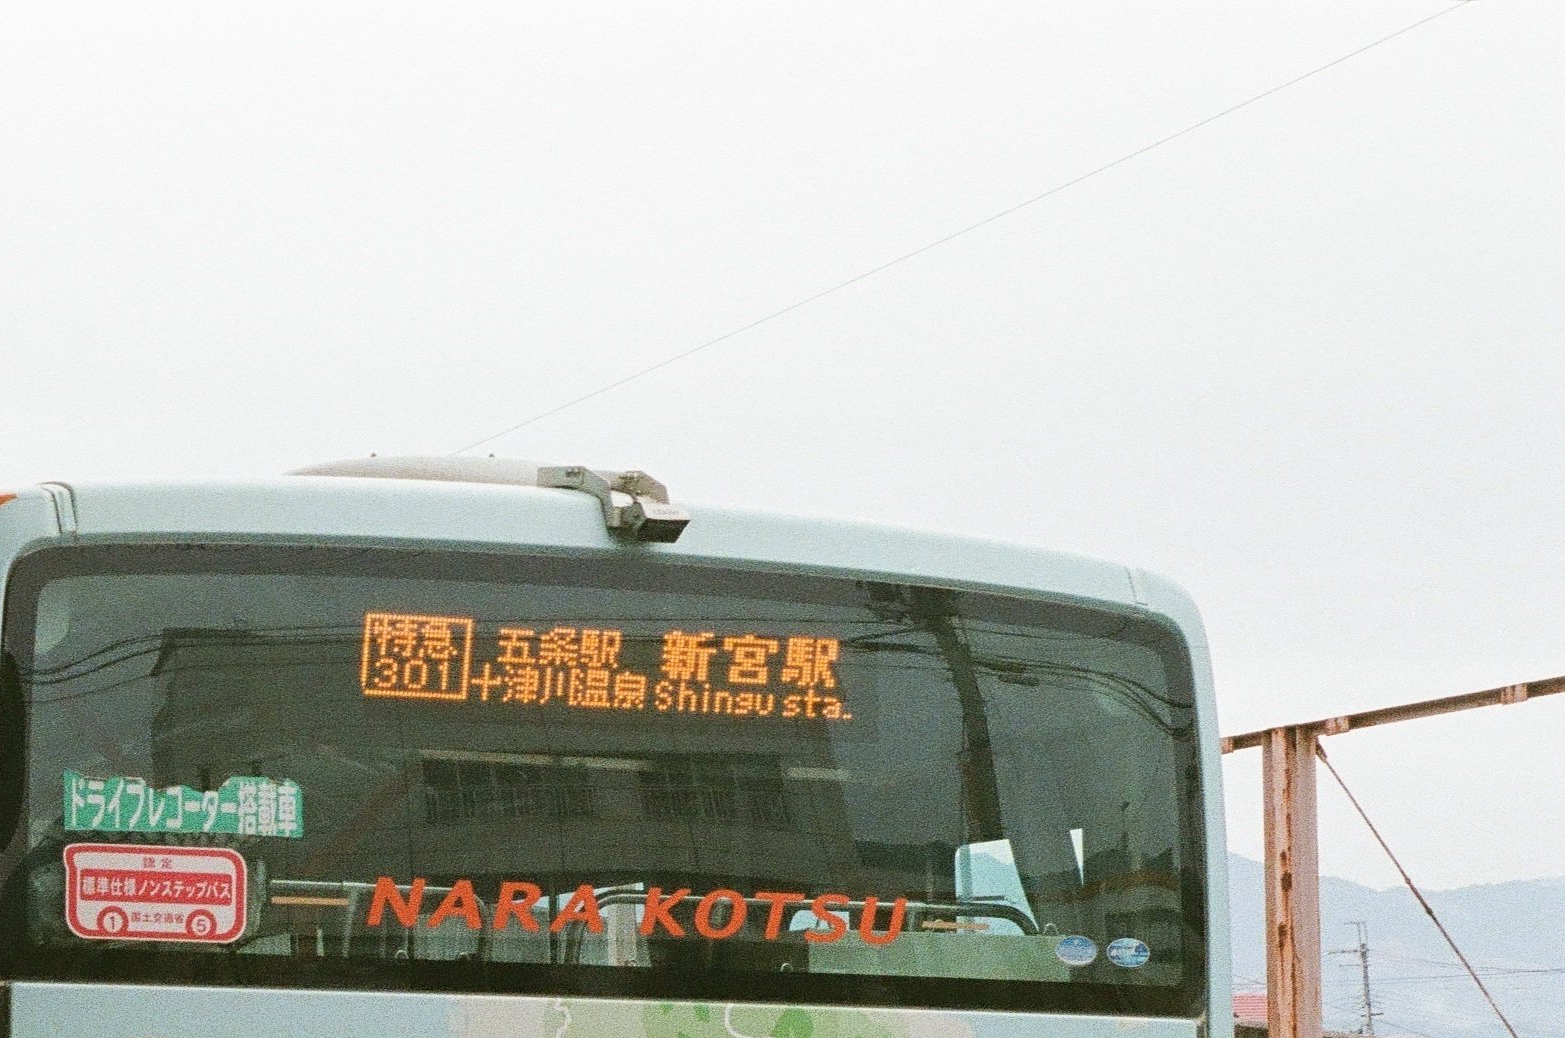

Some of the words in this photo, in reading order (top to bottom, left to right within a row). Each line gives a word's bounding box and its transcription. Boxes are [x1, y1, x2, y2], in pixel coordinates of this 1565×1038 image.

[373, 618, 457, 658] 特急
[497, 626, 623, 668] 五条駅
[661, 630, 839, 689] 新宮駅
[373, 657, 450, 691] 301
[470, 662, 648, 710] 十津川温泉
[654, 680, 775, 715] Shingu
[782, 688, 853, 719] sta.
[82, 875, 232, 900] 標準仕様ノンステップバス
[366, 876, 604, 935] NARA
[640, 887, 908, 946] KOTSU
